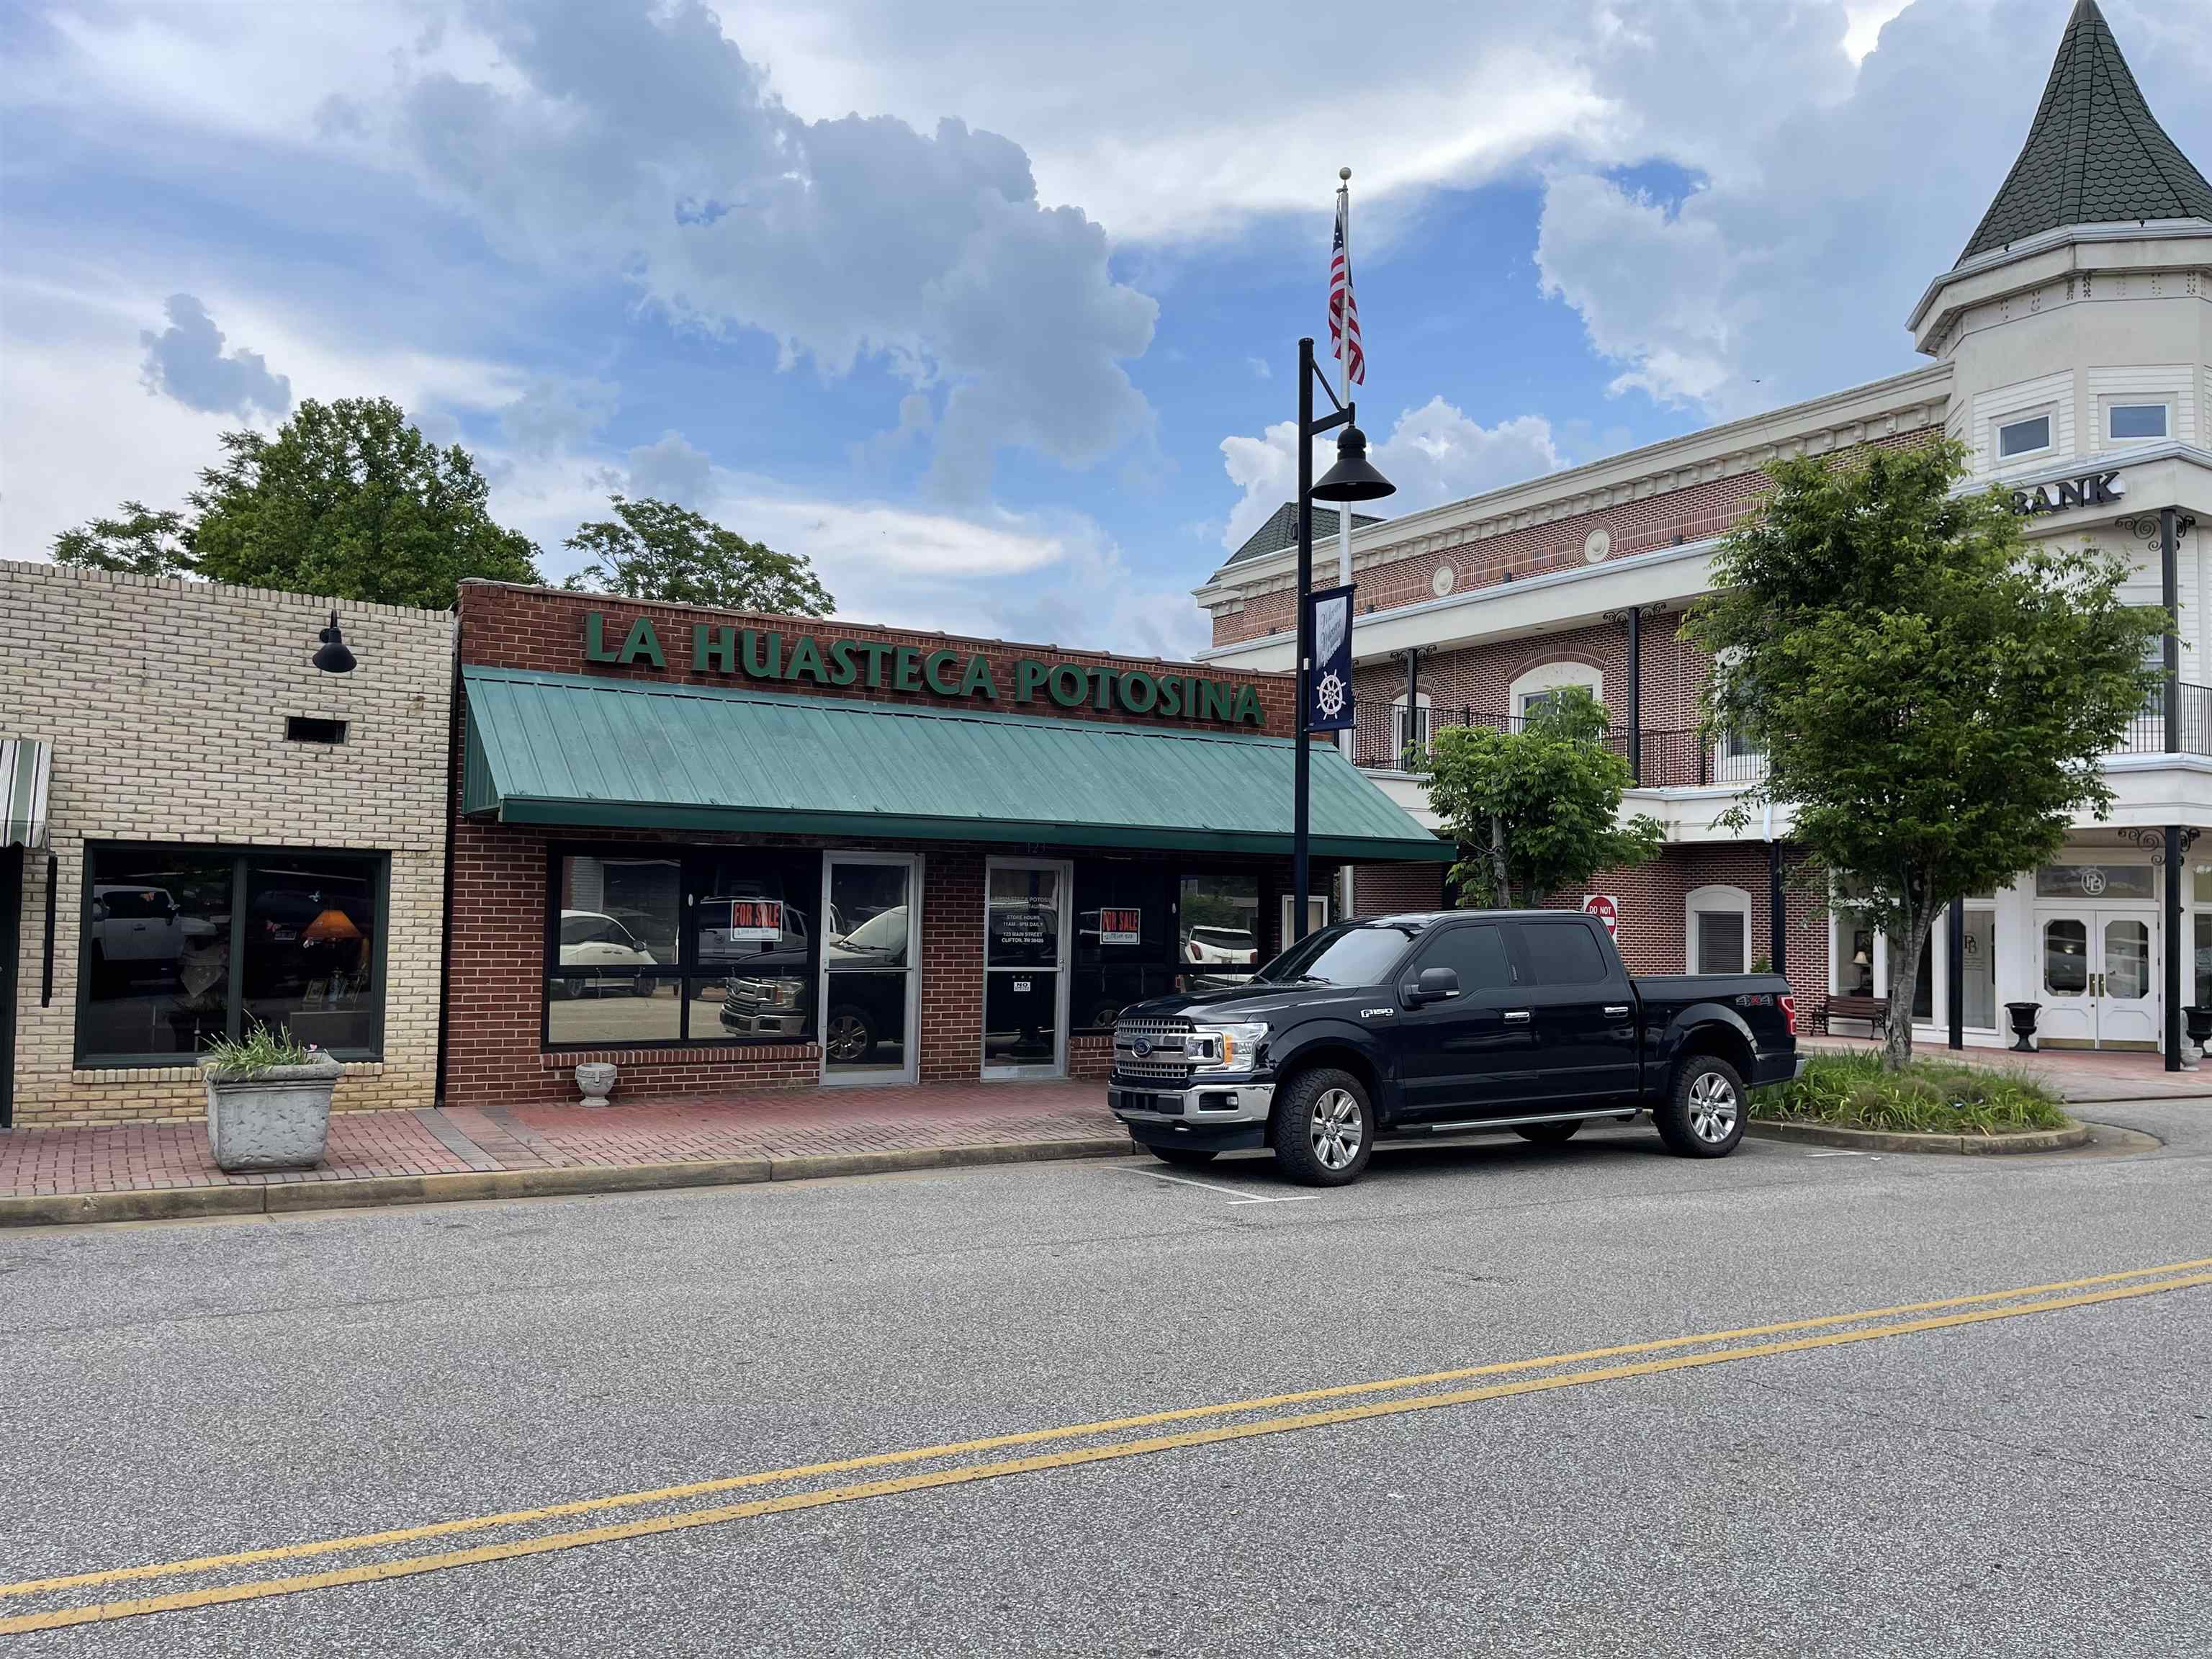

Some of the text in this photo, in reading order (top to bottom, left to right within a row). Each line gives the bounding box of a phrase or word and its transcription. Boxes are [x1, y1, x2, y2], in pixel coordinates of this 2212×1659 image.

[2012, 472, 2126, 516] BANK
[586, 611, 1266, 724] LA HUASTECA POTOSINA
[734, 903, 780, 927] FOR SALE
[1102, 911, 1138, 931] FOR SALE
[1589, 905, 1612, 915] DO NOT
